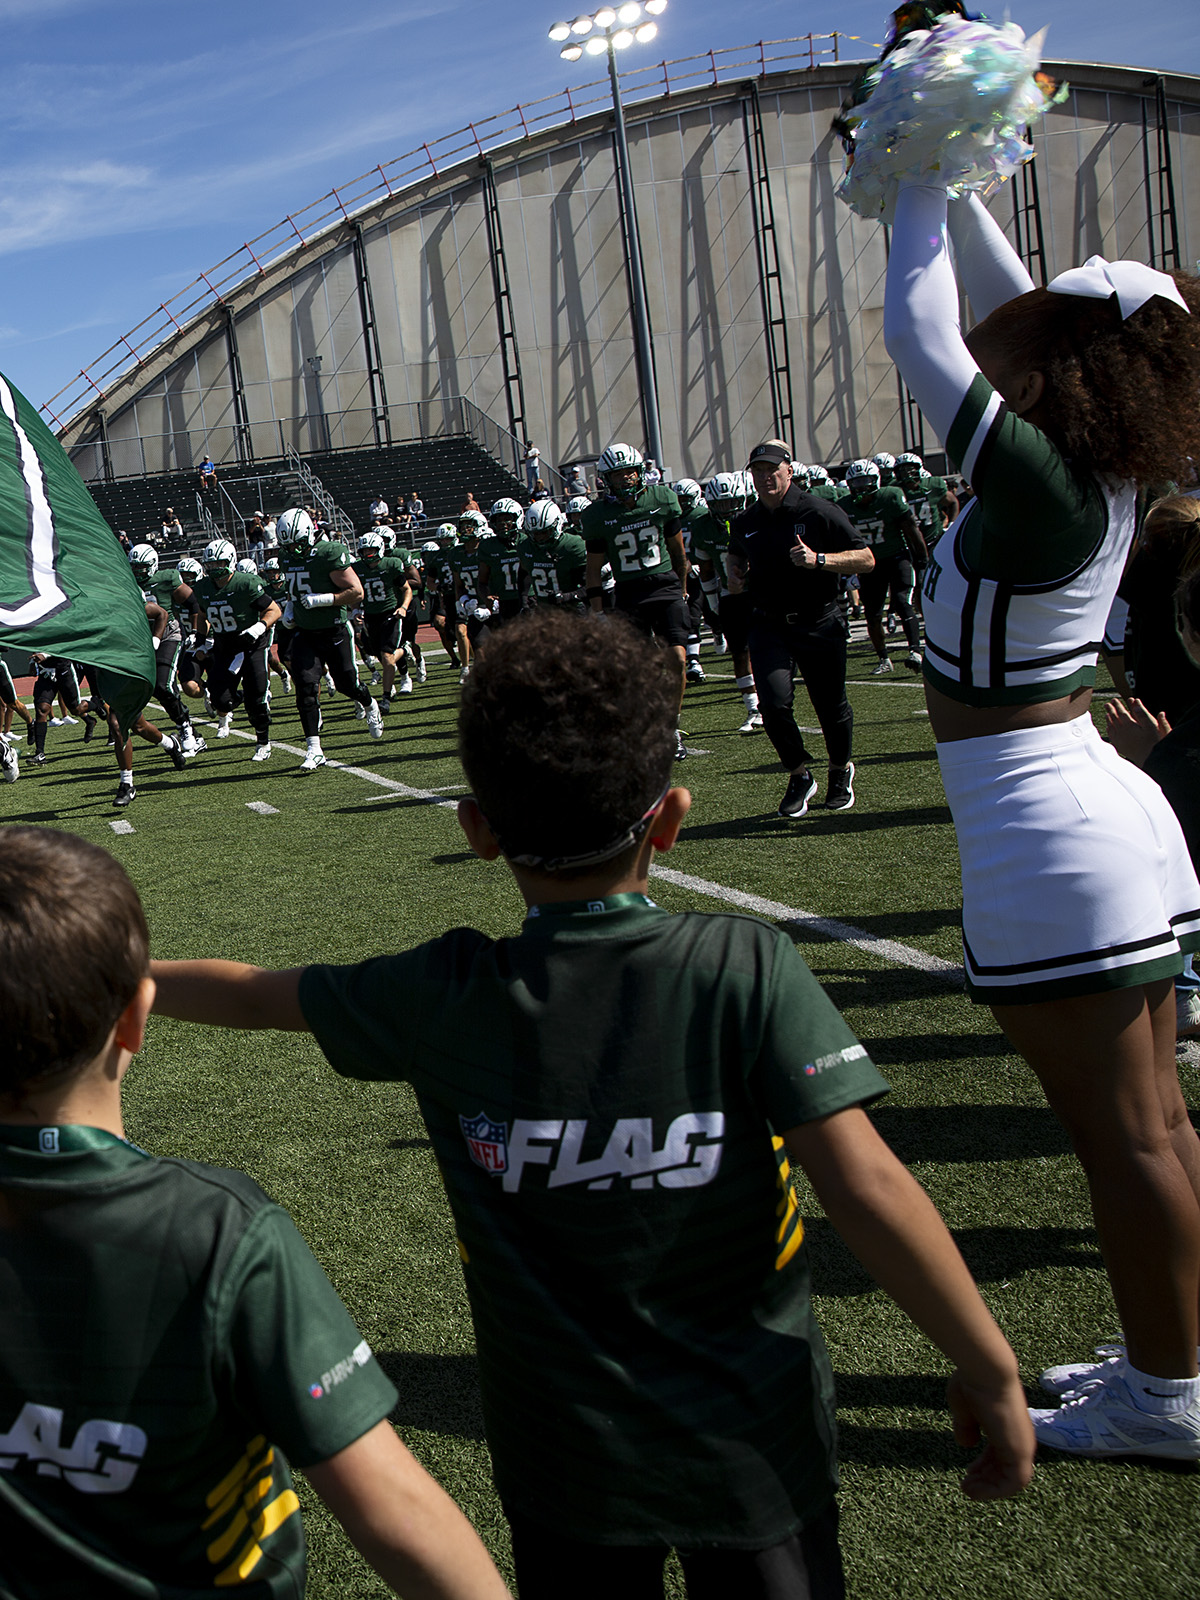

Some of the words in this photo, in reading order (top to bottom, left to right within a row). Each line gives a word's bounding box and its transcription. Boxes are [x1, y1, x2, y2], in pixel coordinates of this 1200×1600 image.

[615, 450, 625, 461] D
[721, 483, 728, 493] D
[531, 517, 538, 527] D
[855, 520, 885, 545] 57
[281, 530, 288, 540] D
[310, 547, 318, 557] C
[613, 525, 661, 571] 23
[285, 572, 312, 602] 75
[364, 580, 386, 603] 13
[531, 568, 560, 597] 21
[207, 604, 238, 634] 66
[468, 1138, 505, 1171] NFL
[503, 1111, 725, 1193] FLAG
